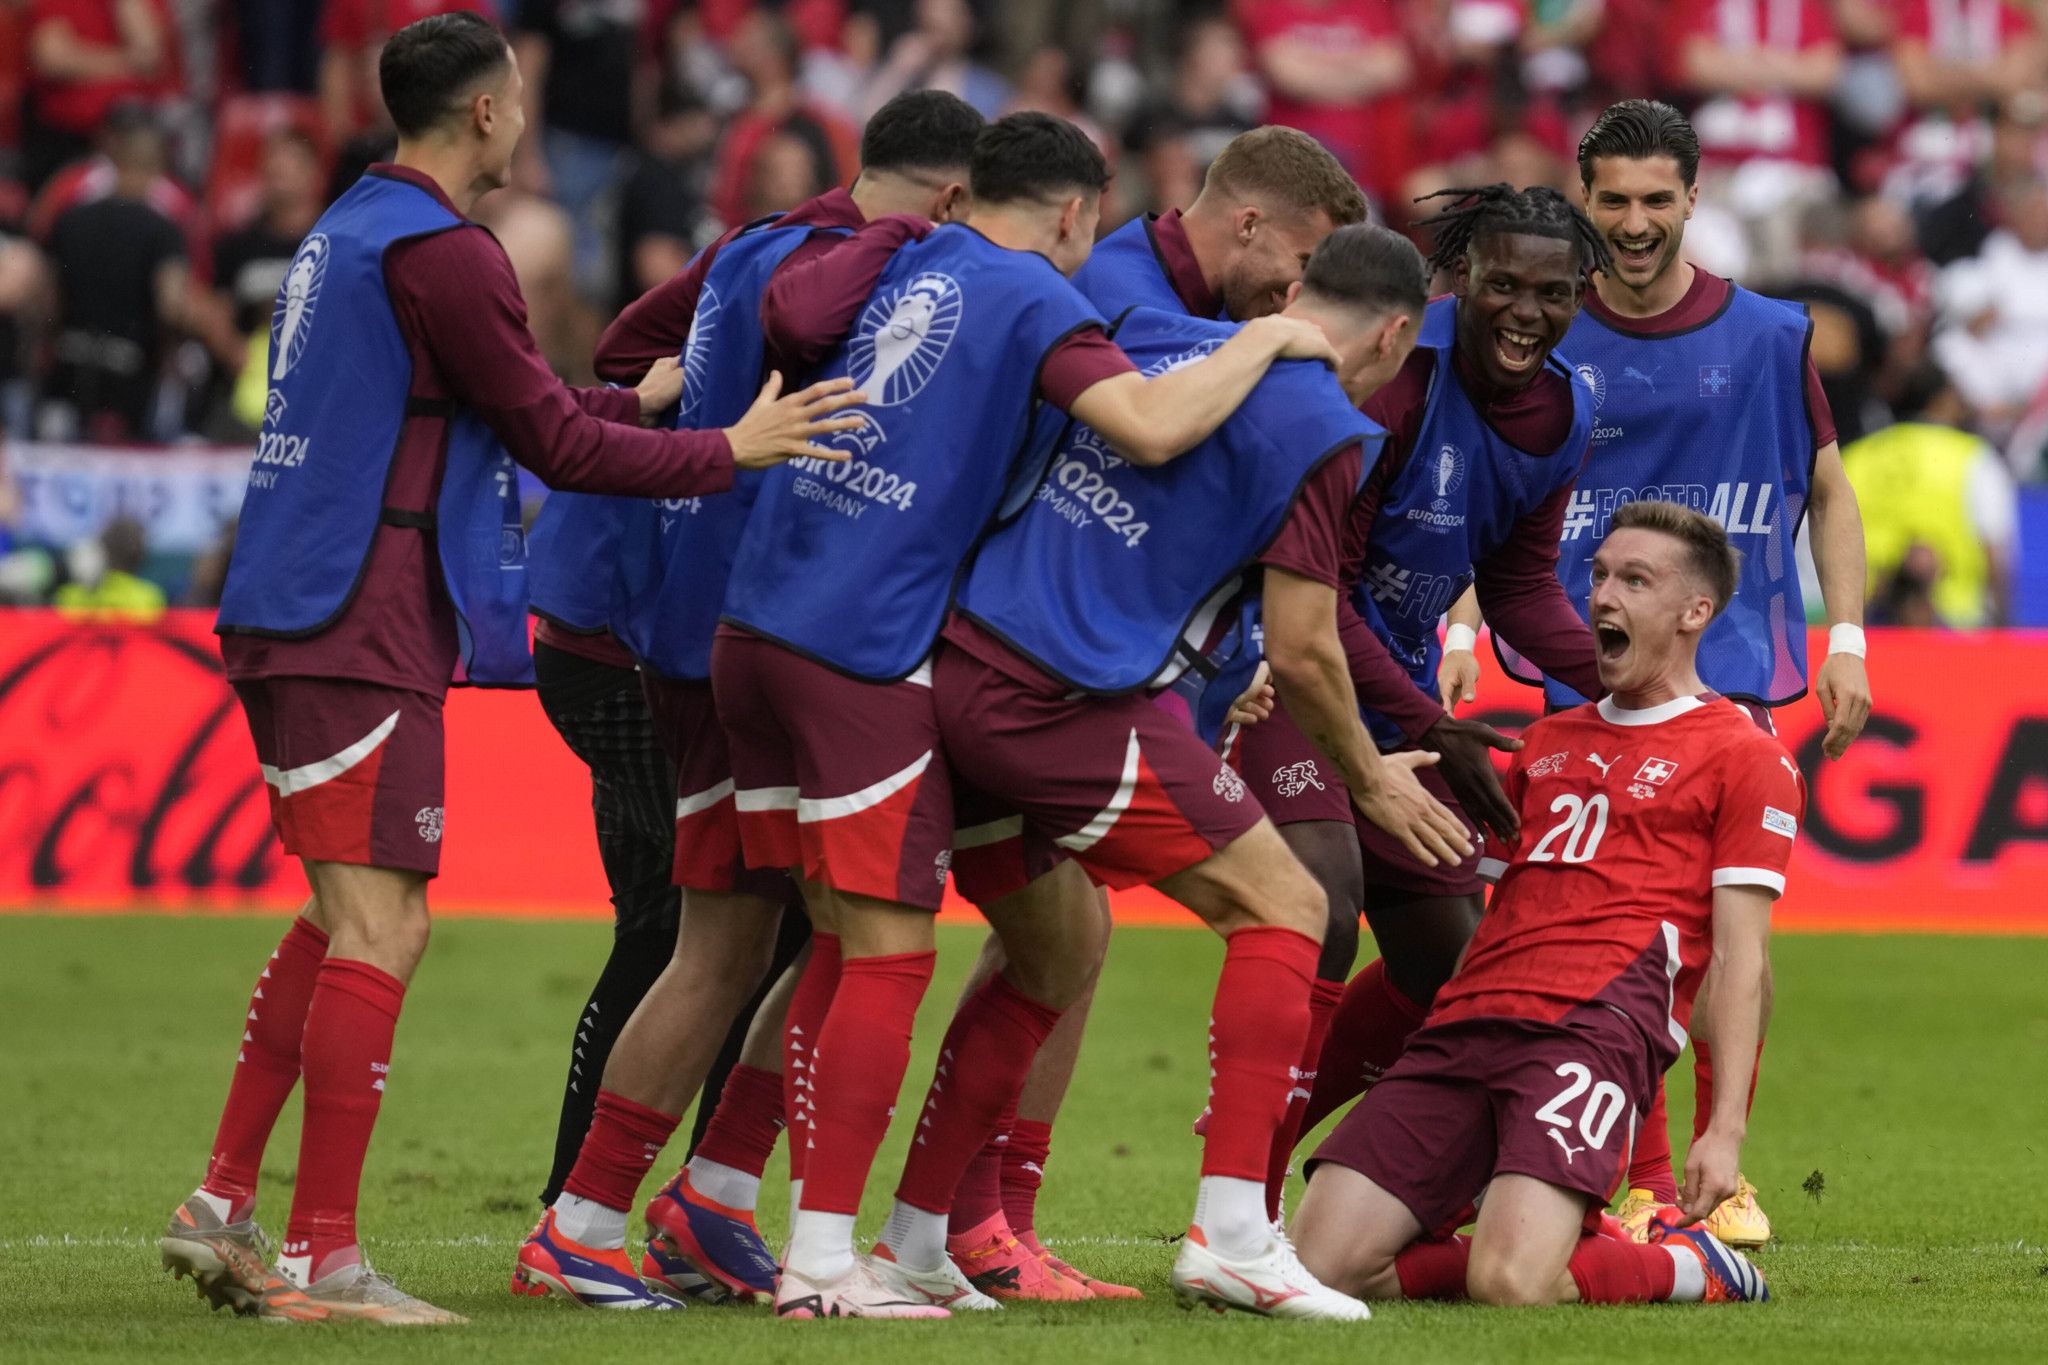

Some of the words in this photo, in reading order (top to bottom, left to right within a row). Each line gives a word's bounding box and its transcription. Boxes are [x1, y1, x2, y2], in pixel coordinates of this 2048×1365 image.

[1591, 426, 1625, 439] 2024
[788, 440, 917, 511] URO2024
[792, 476, 868, 519] GERMANY
[1406, 509, 1465, 526] EURO2024
[1527, 793, 1610, 863] 20
[1535, 1061, 1626, 1150] 20
